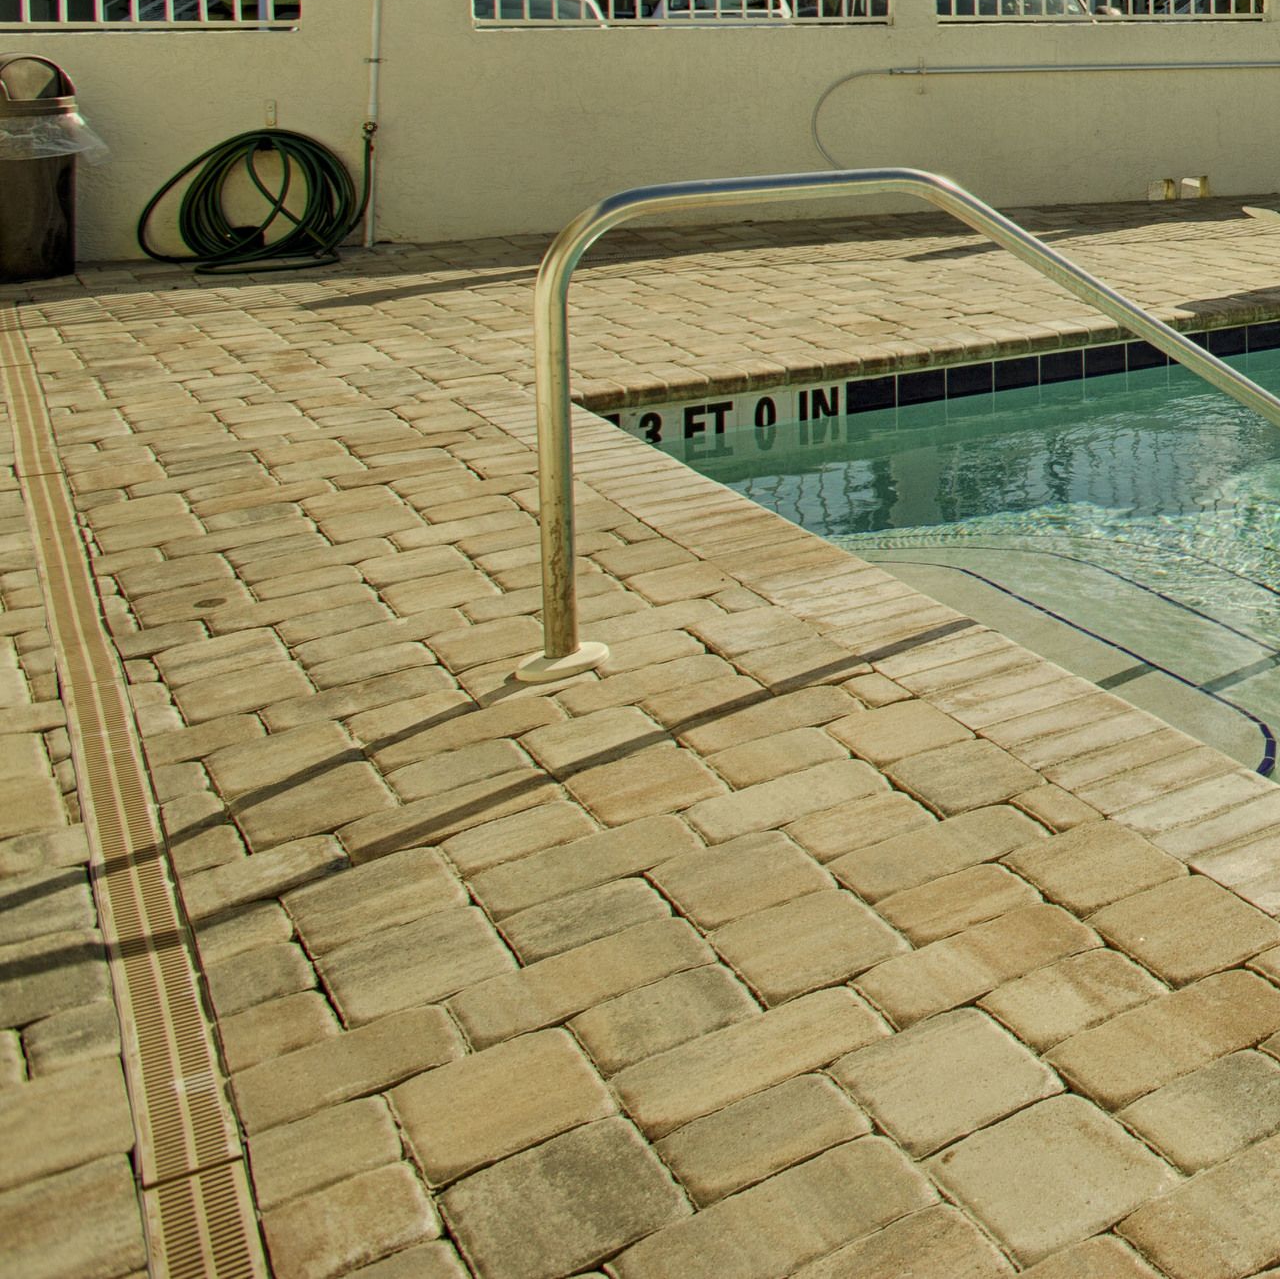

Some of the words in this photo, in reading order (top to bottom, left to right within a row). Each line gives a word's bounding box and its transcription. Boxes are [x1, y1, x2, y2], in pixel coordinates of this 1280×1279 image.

[639, 411, 662, 444] 3
[684, 401, 733, 439] FT
[755, 396, 776, 427] 0
[799, 386, 839, 421] IN
